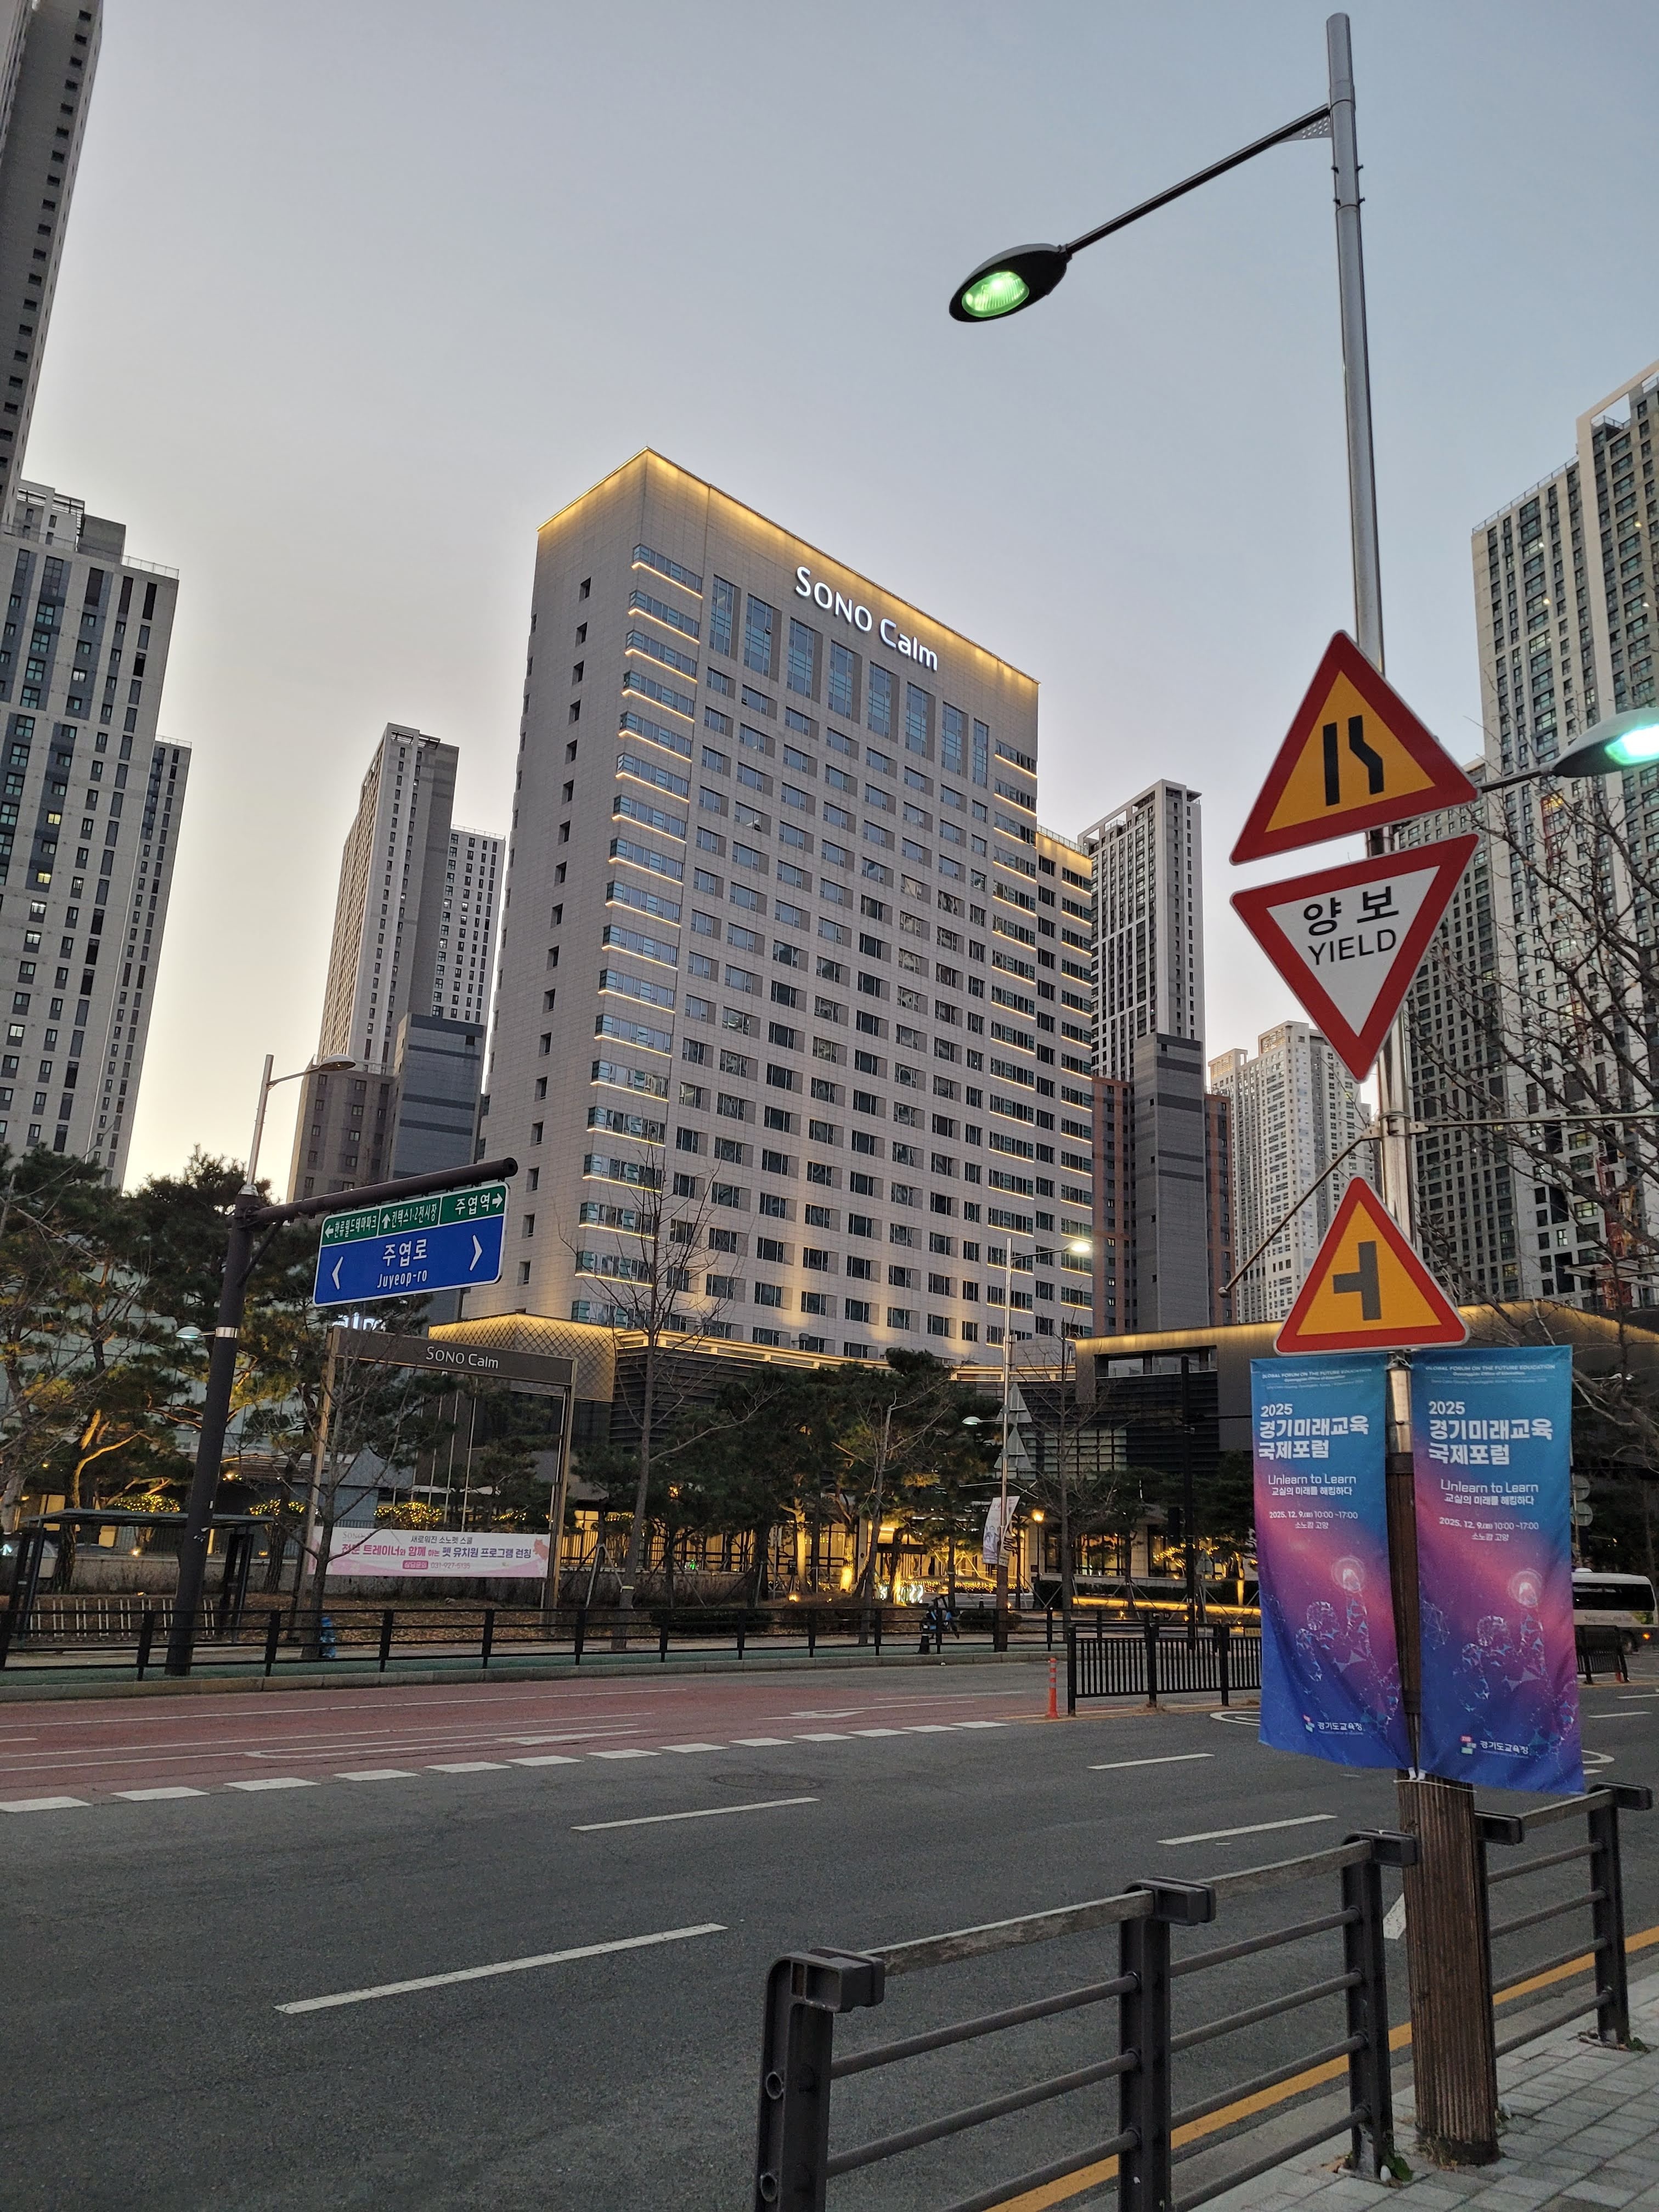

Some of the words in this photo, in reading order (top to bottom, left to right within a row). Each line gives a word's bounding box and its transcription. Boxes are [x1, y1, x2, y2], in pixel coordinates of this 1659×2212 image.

[795, 566, 872, 631] SONO
[880, 618, 938, 671] Calm
[1308, 929, 1396, 965] YIELD
[455, 1193, 490, 1215] 주엽역
[382, 1238, 427, 1267] 주엽로
[377, 1269, 427, 1289] Juyeop-ro
[426, 1346, 465, 1364] SONO
[468, 1353, 499, 1369] Calm
[1260, 1403, 1293, 1417] 2025
[1428, 1401, 1465, 1415] 2025
[1260, 1415, 1369, 1439] 경기미래교육
[1429, 1418, 1553, 1441] 경기미래교육
[1259, 1440, 1329, 1460] 국제포럼
[1427, 1442, 1510, 1465] 국제포럼
[1268, 1474, 1307, 1485] Unlearn
[1310, 1474, 1321, 1484] to
[1324, 1473, 1356, 1484] Learn
[1441, 1479, 1487, 1493] Unlearn
[1491, 1482, 1503, 1493] to
[1505, 1482, 1539, 1493] Learn
[1272, 1487, 1294, 1496] 교실의
[1295, 1486, 1318, 1496] 미래를
[1320, 1486, 1352, 1496] 해킹하다
[1444, 1493, 1471, 1505] 교실의
[1474, 1496, 1499, 1505] 미래를
[1501, 1496, 1534, 1505] 해킹하다
[1494, 1522, 1514, 1530] 10:00
[363, 1544, 405, 1556] 트레이너와
[409, 1545, 426, 1556] 함께
[442, 1547, 451, 1557] 펫
[453, 1547, 478, 1558] 유치원
[481, 1548, 514, 1558] 프로그램
[516, 1548, 531, 1559] 런칭
